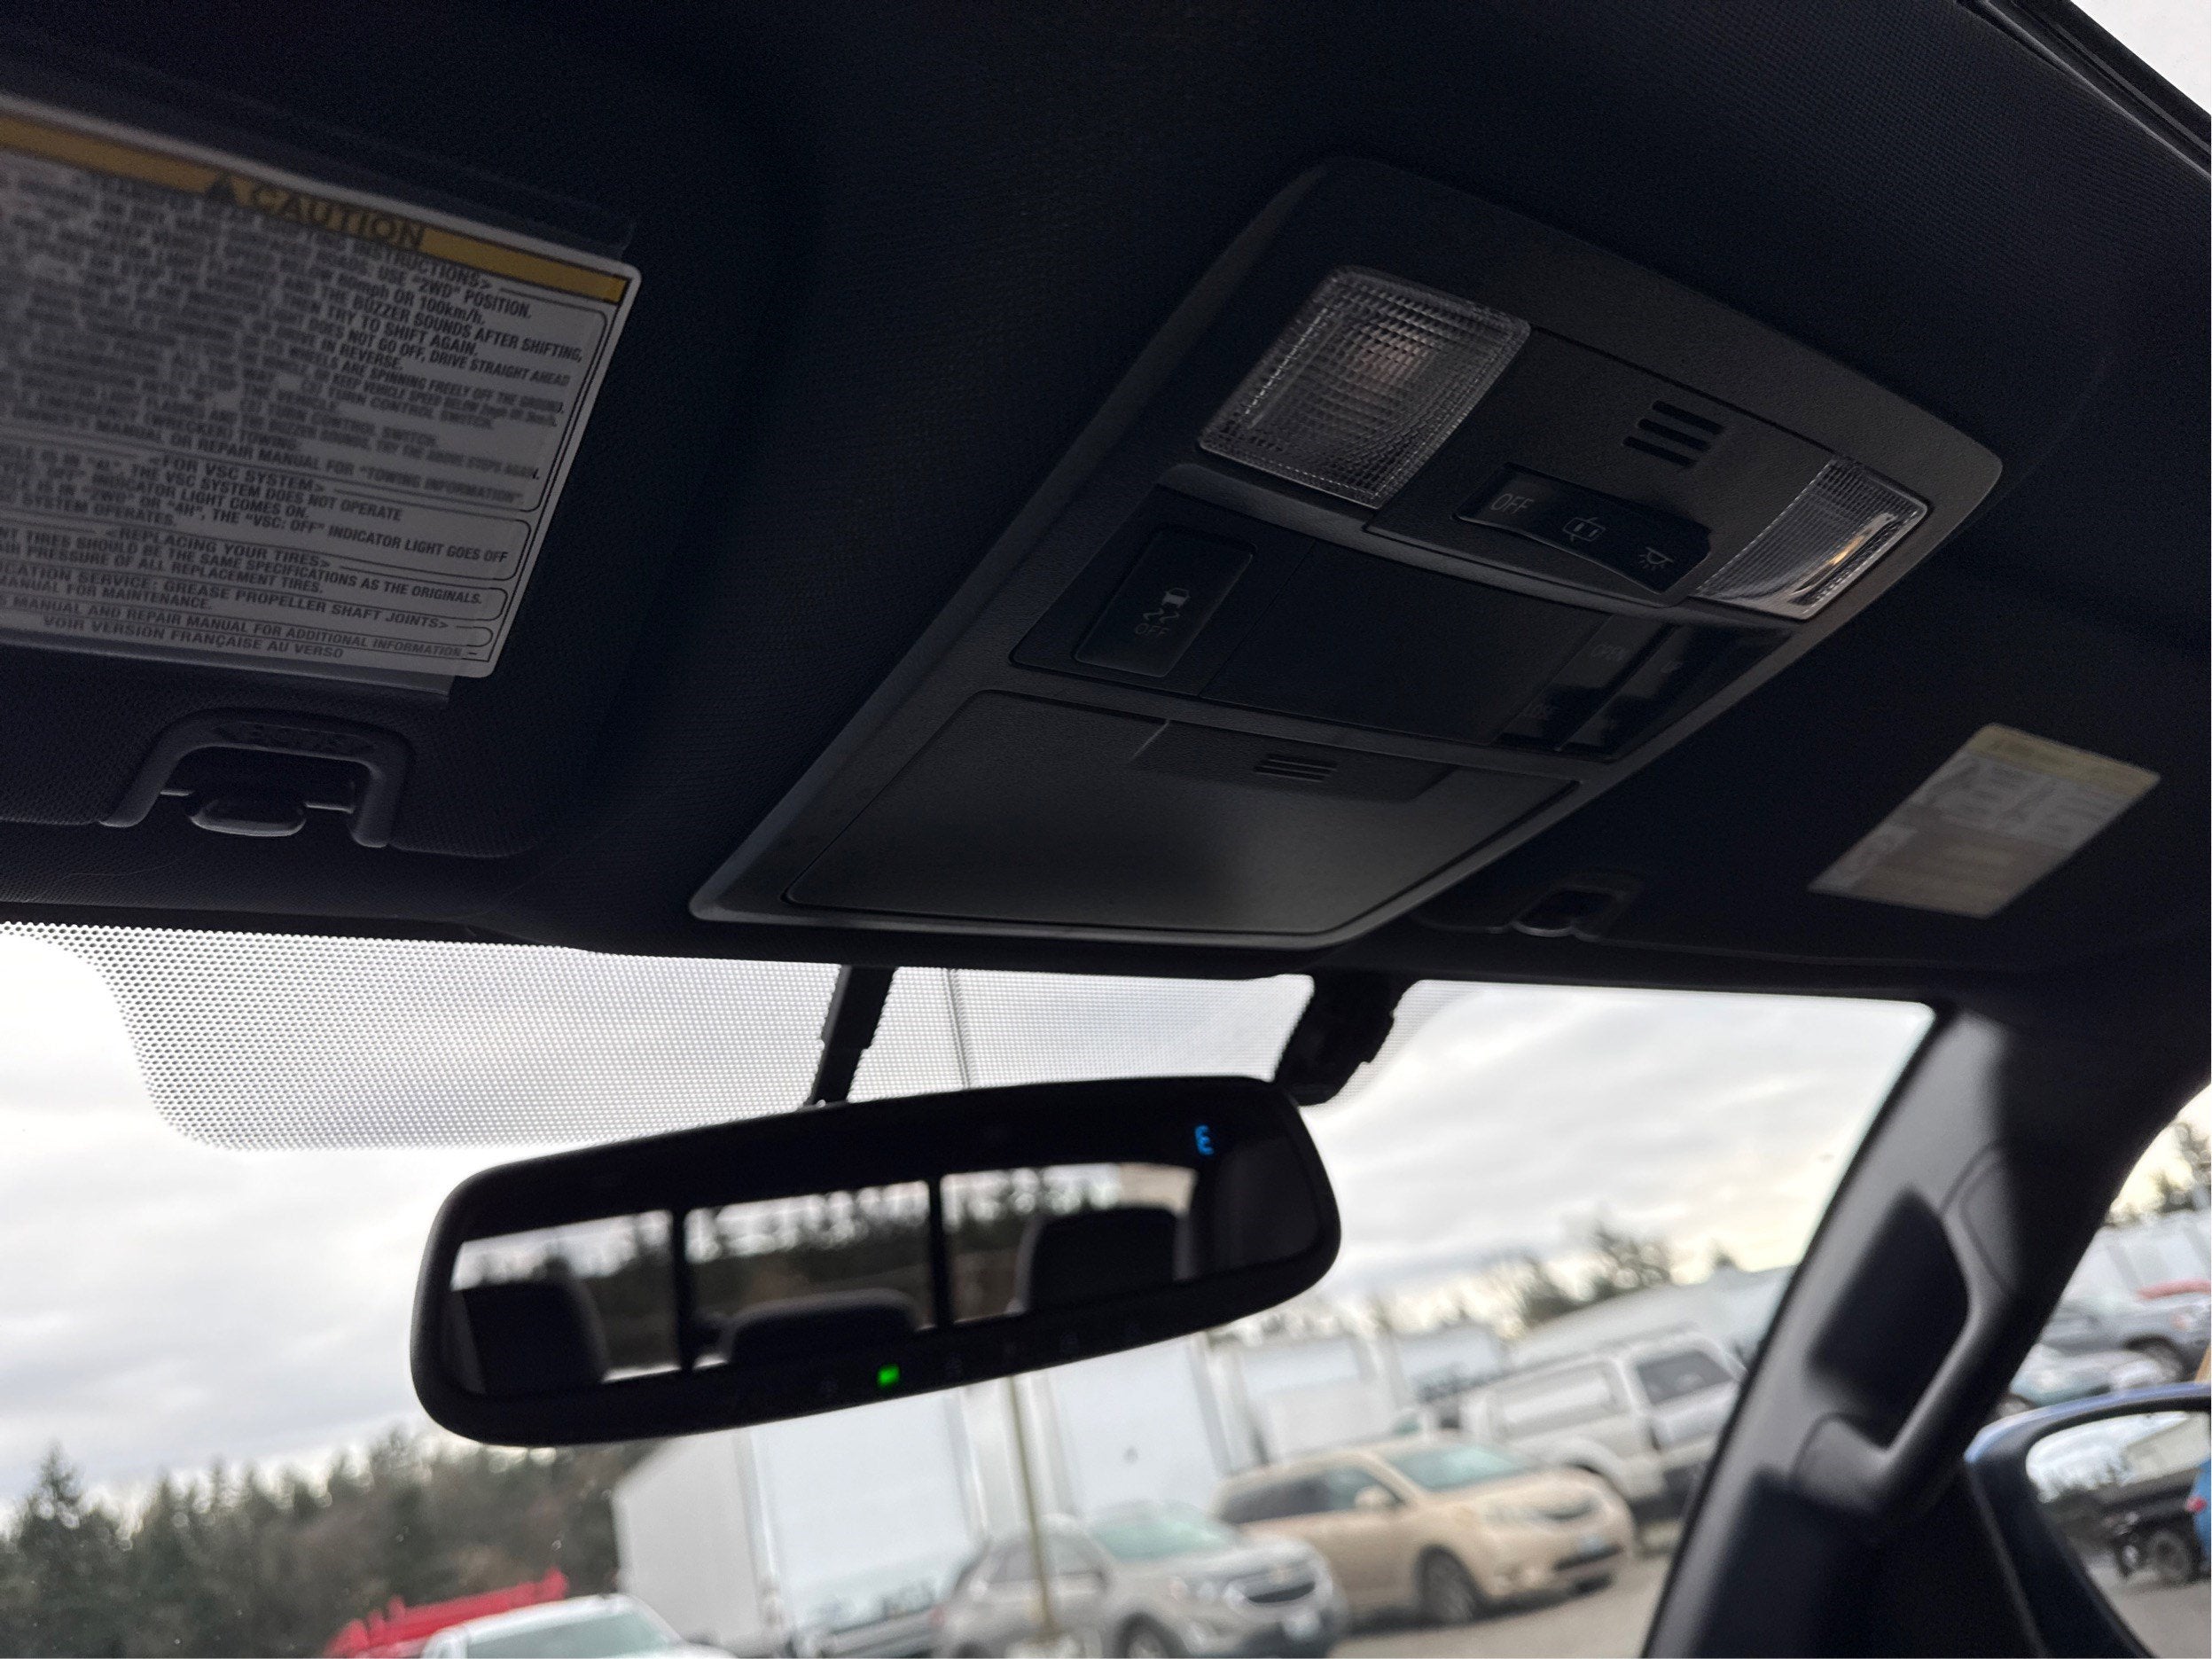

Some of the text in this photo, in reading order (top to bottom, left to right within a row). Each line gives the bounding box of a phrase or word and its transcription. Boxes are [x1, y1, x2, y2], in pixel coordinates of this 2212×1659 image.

[246, 182, 426, 250] CAUTION
[391, 289, 416, 308] OR
[462, 288, 535, 320] POSITION.
[352, 295, 411, 325] BUZZER
[411, 311, 473, 340] SOUNDS
[473, 326, 520, 349] AFTER
[519, 336, 585, 364] SHIFTING,
[358, 315, 382, 334] TO
[381, 321, 428, 345] SHIFT
[427, 332, 481, 357] AGAIN.
[337, 342, 407, 372] REVERSE.
[340, 357, 369, 378] ARE
[368, 366, 428, 389] SPINNING
[345, 329, 376, 349] NOT
[375, 336, 398, 355] GO
[397, 342, 429, 362] OFF,
[428, 349, 469, 370] DRIVE
[468, 356, 530, 380] STRAIGHT
[528, 368, 572, 388] AHEAD
[256, 448, 321, 471] MANUAL
[202, 463, 241, 481] VSC
[243, 469, 326, 494] SYSTEM>
[163, 470, 196, 489] VSC
[199, 477, 263, 498] SYSTEM
[264, 487, 306, 505] DOES
[306, 494, 338, 511] NOT
[337, 499, 404, 521] OPERATE
[178, 489, 226, 508] LIGHT
[229, 497, 283, 516] COMES
[283, 505, 311, 520] ON.
[1490, 492, 1535, 513] OFF
[210, 507, 243, 524] THE
[325, 525, 403, 550] INDICATOR
[403, 537, 445, 556] LIGHT
[445, 544, 483, 560] GOES
[481, 549, 509, 563] OFF
[25, 529, 74, 548] TIRES
[73, 536, 138, 556] SHOULD
[139, 544, 165, 560] BE
[167, 548, 196, 563] THE
[198, 552, 244, 570] SAME
[244, 559, 359, 587] SPECIFICATIONS
[359, 575, 381, 591] AS
[381, 580, 410, 596] THE
[410, 584, 485, 605] ORIGINALS.
[25, 544, 112, 566] PRESSURE
[112, 554, 136, 568] OF
[137, 558, 168, 573] ALL
[168, 561, 277, 587] REPLACEMENT
[278, 575, 326, 593] TIRES.
[222, 542, 270, 560] YOUR
[272, 549, 332, 569] TIRES>
[64, 583, 98, 598] FOR
[99, 588, 215, 611] MAINTENANCE.
[161, 580, 232, 600] GREASE
[233, 589, 328, 613] PROPELLER
[330, 602, 383, 622] SHAFT
[383, 610, 451, 630] JOINTS>
[12, 595, 83, 614] MANUAL
[86, 603, 123, 619] AND
[124, 607, 183, 626] REPAIR
[184, 614, 251, 633] MANUAL
[252, 622, 283, 637] FOR
[285, 627, 371, 648] ADDITIONAL
[371, 638, 464, 657] INFORMATION
[89, 621, 166, 641] VERSION
[168, 630, 264, 651] FRANÇAISE
[266, 639, 291, 653] AU
[292, 642, 346, 659] VERSO
[1135, 622, 1170, 637] OFF
[1194, 1124, 1214, 1155] E
